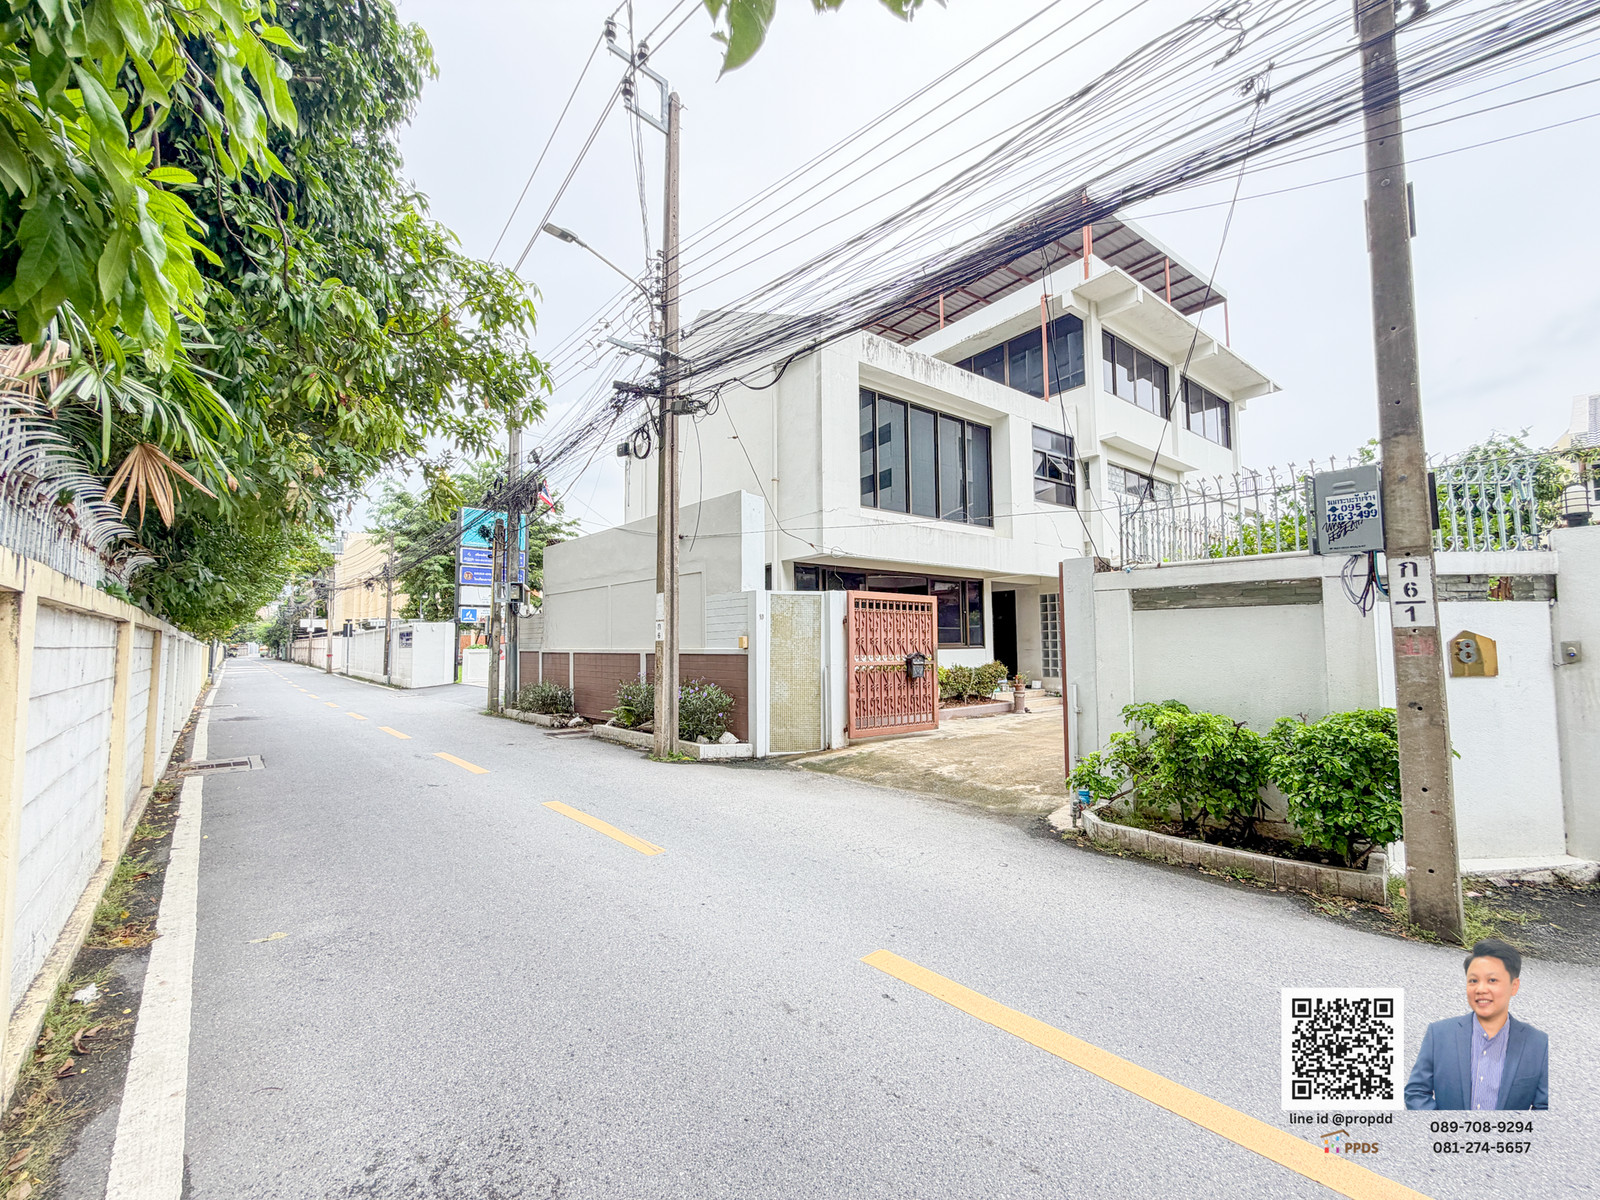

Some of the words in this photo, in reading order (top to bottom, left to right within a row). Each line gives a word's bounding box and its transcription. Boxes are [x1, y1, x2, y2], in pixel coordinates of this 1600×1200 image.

[1341, 502, 1362, 512] 095
[1327, 508, 1378, 523] 126-3-499
[1403, 582, 1419, 598] 6
[1404, 605, 1417, 622] 1
